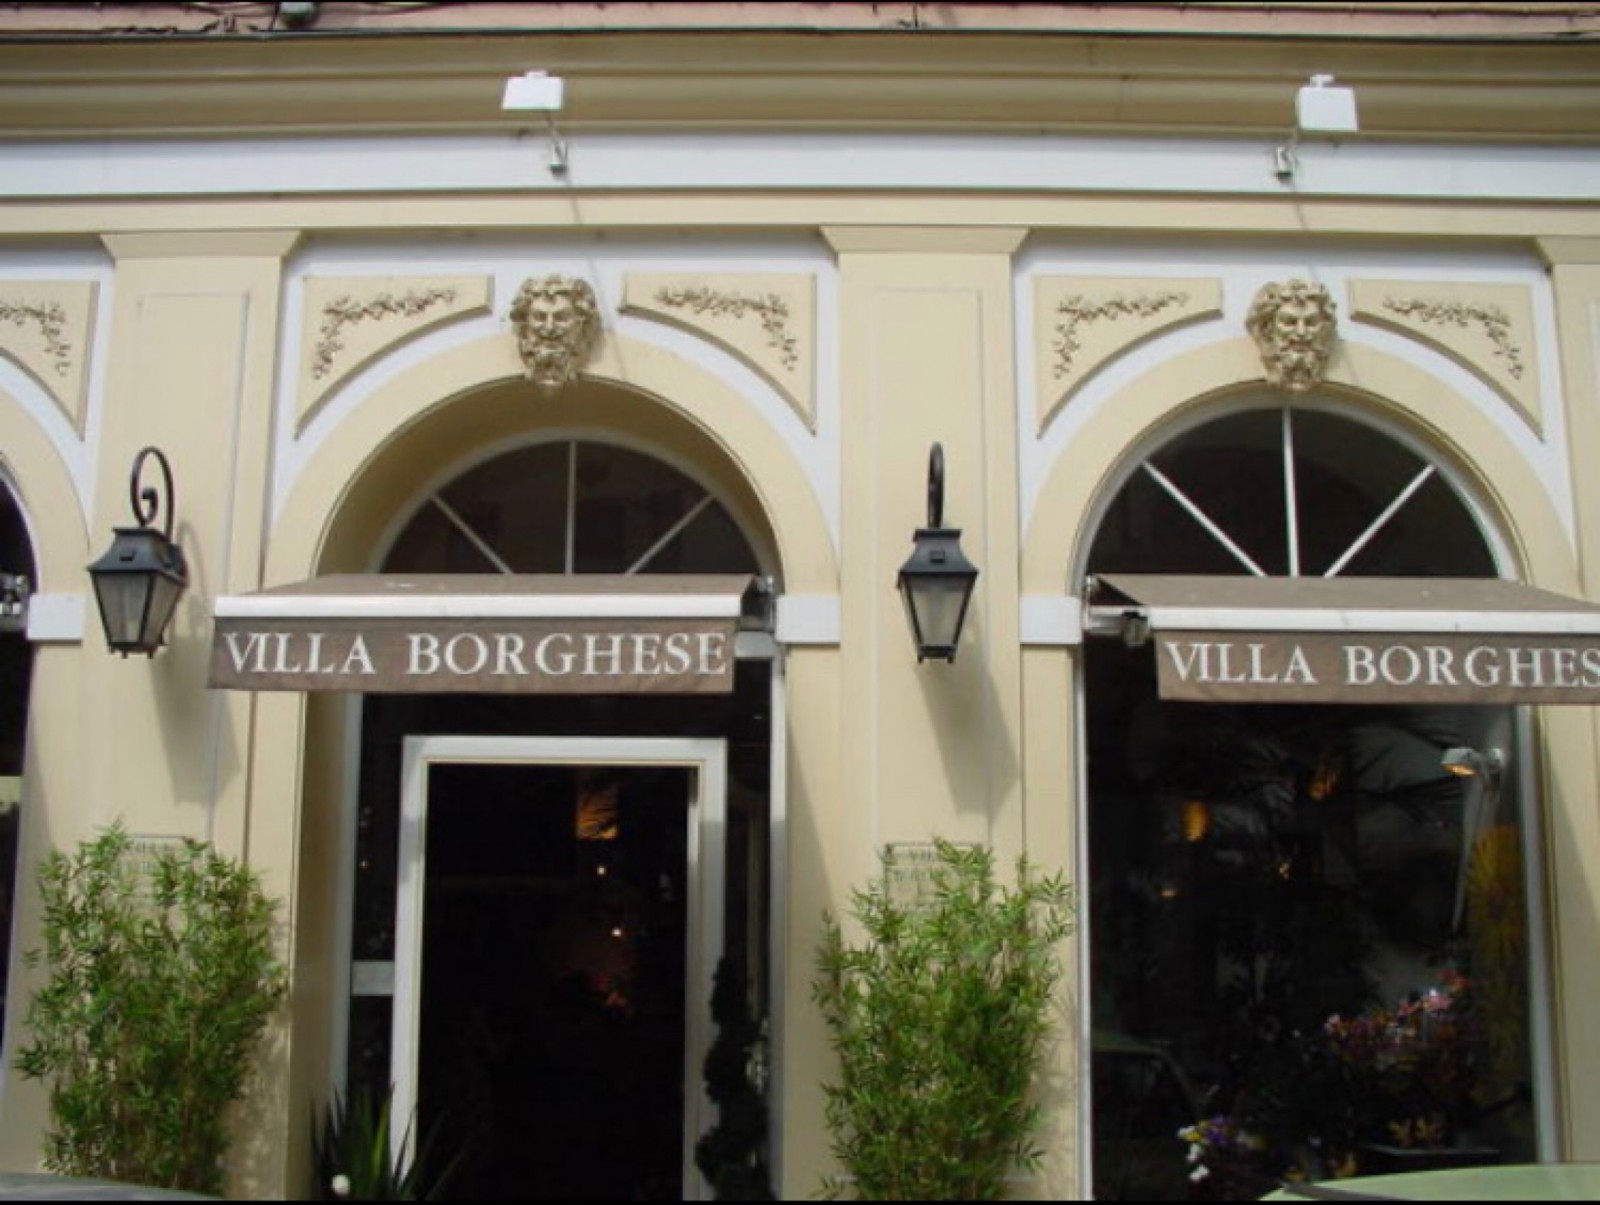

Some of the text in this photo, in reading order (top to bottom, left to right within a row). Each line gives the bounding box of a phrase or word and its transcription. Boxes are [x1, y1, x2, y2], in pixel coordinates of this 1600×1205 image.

[224, 632, 727, 675] VILLA BORGHESE
[1165, 641, 1600, 688] VILLA BORGHES
